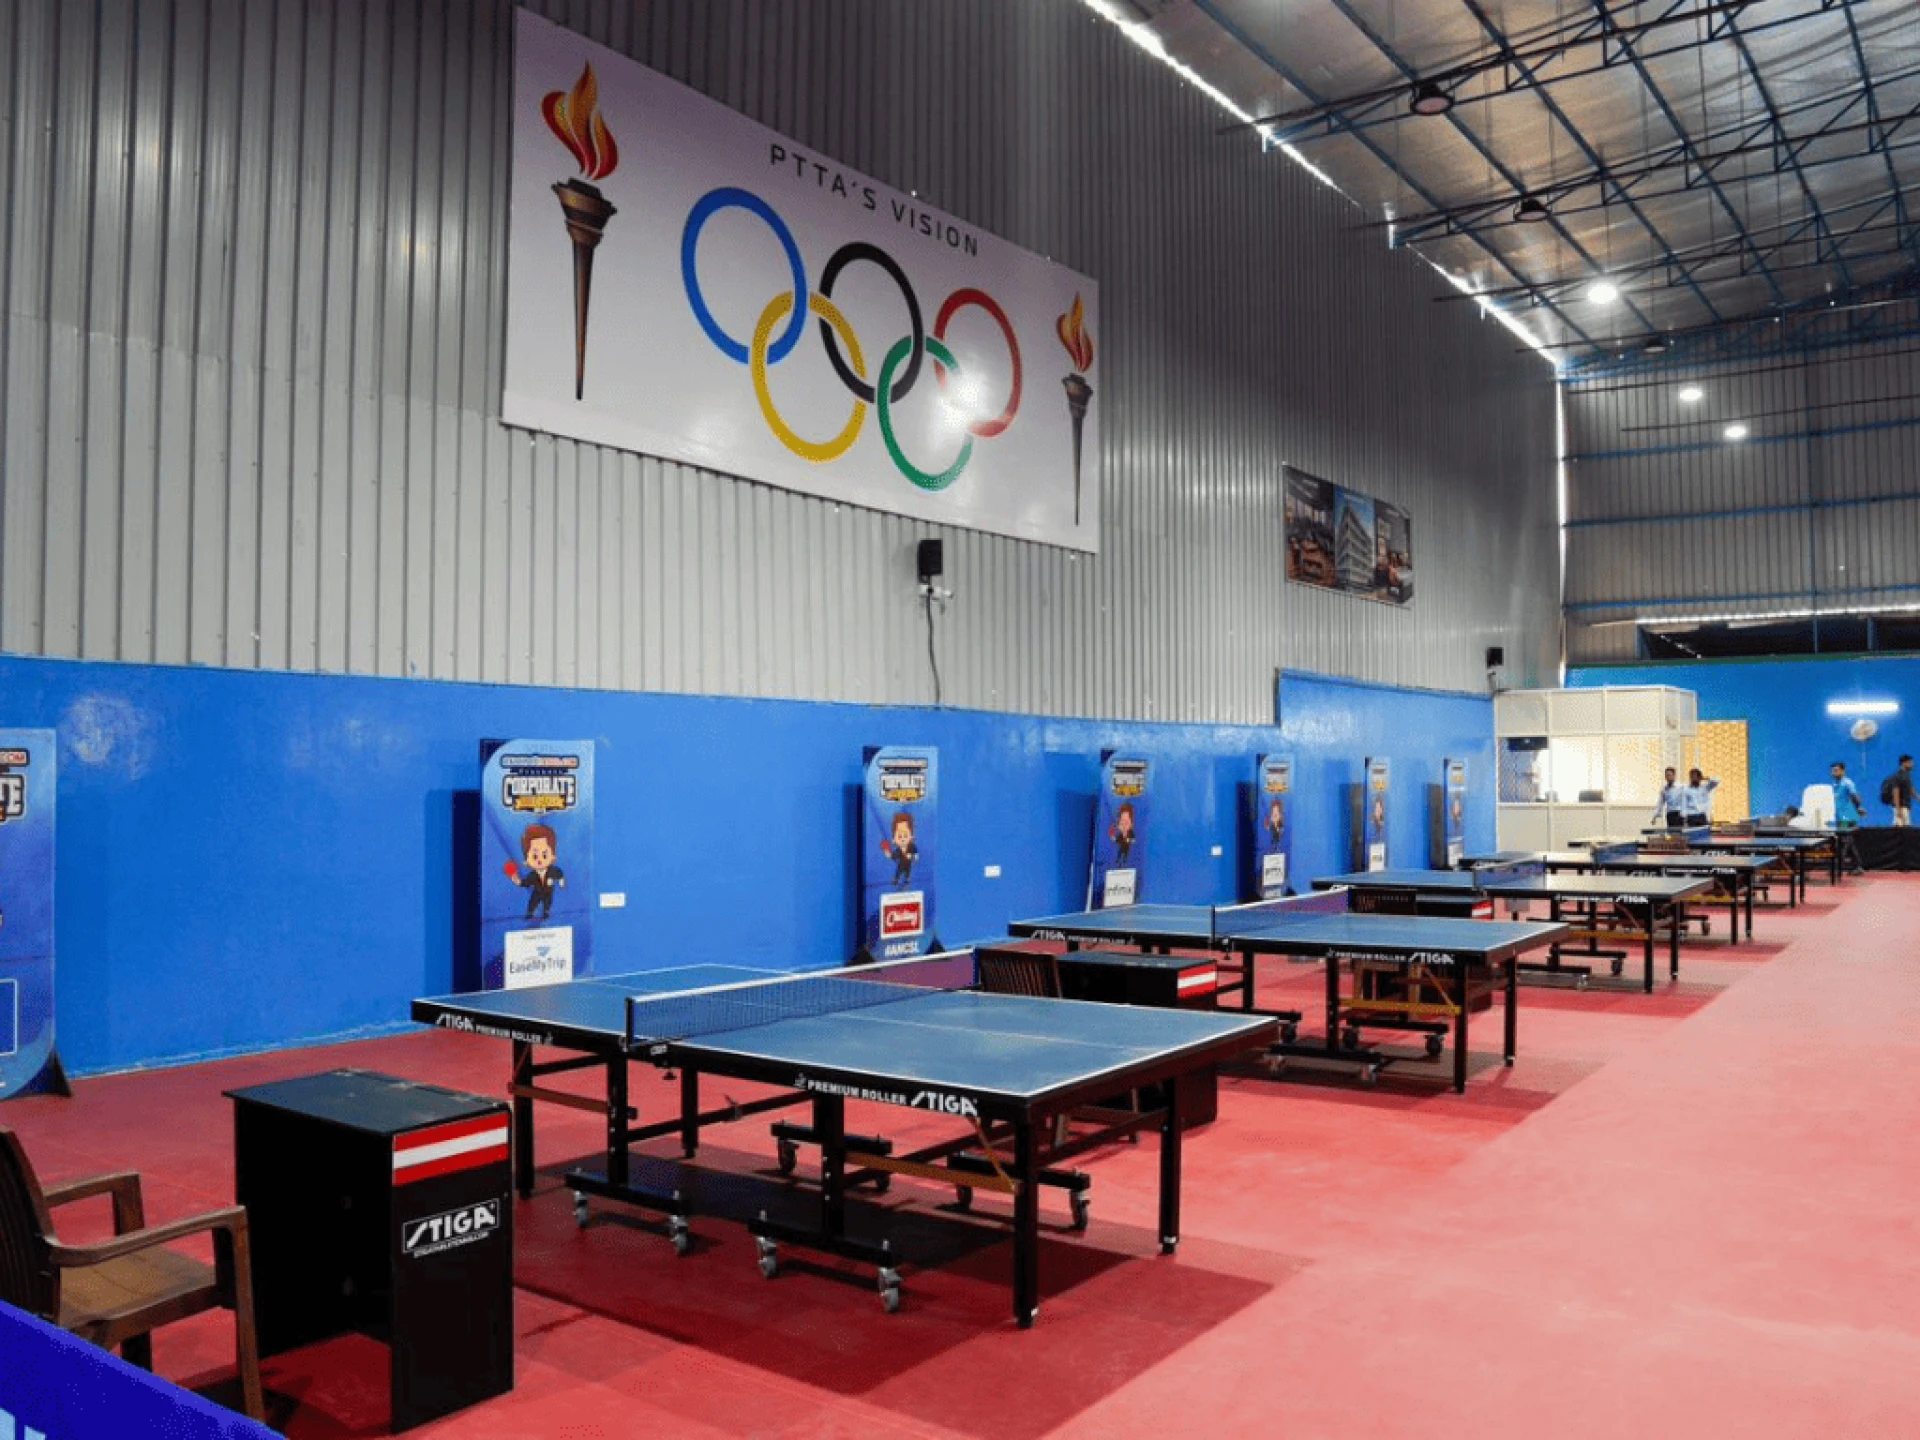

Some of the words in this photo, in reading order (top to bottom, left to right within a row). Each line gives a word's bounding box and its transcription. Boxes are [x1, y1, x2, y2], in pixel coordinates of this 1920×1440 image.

[770, 143, 877, 211] PTTA'S
[891, 198, 978, 258] VISION
[436, 1012, 475, 1032] STIGA
[807, 1079, 860, 1099] PREMIUM
[861, 1088, 907, 1106] ROLLER
[910, 1090, 978, 1117] STIGA
[406, 1203, 497, 1250] STIGA
